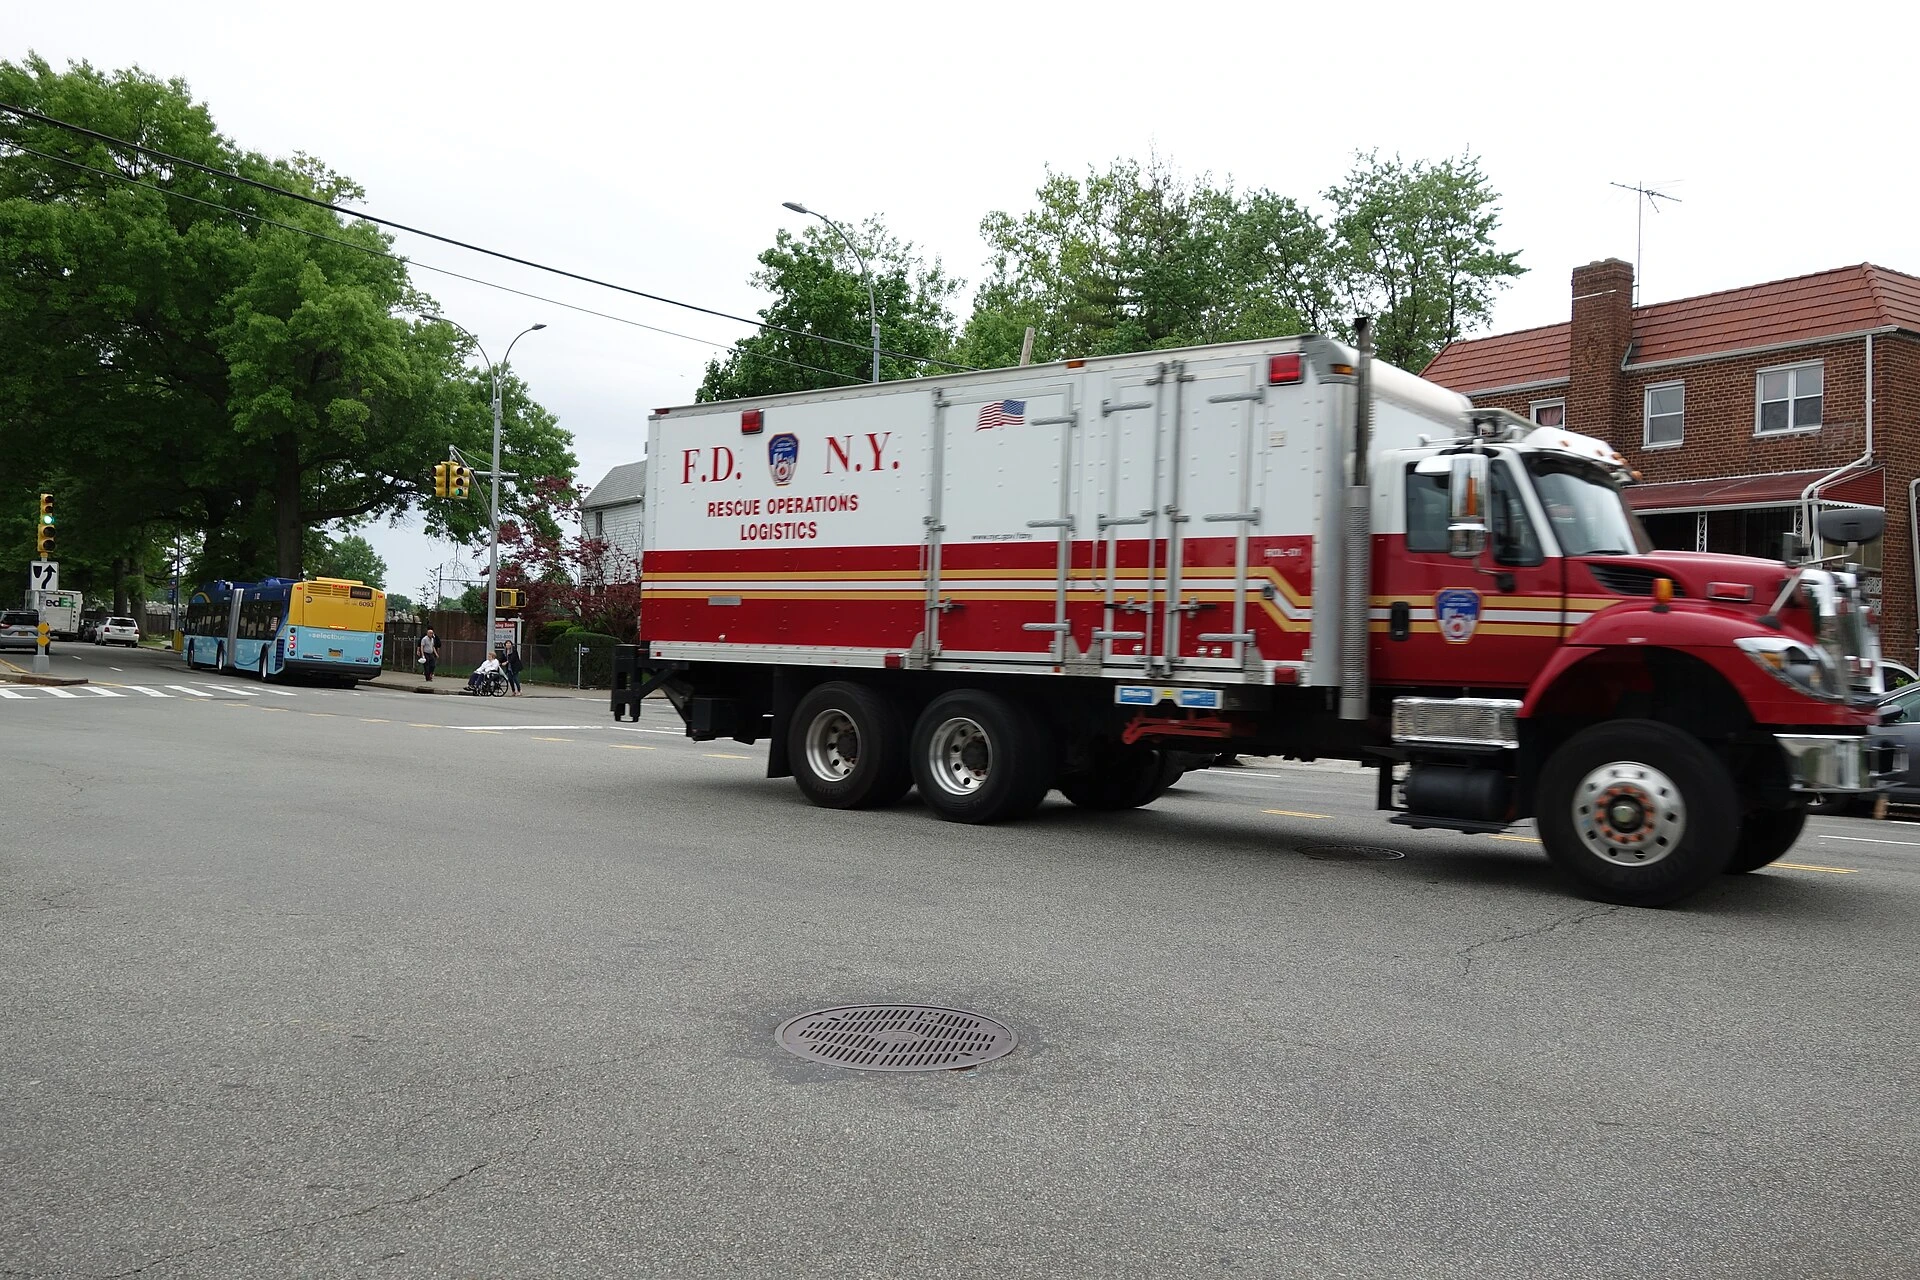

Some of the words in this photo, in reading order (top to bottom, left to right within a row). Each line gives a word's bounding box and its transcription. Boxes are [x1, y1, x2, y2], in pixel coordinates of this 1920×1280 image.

[680, 446, 742, 484] F.D.
[822, 431, 900, 475] N.Y.
[707, 499, 760, 518] RESCUE
[767, 494, 860, 515] OPERATIONS
[740, 521, 818, 541] LOGISTICS
[45, 596, 77, 608] edEx
